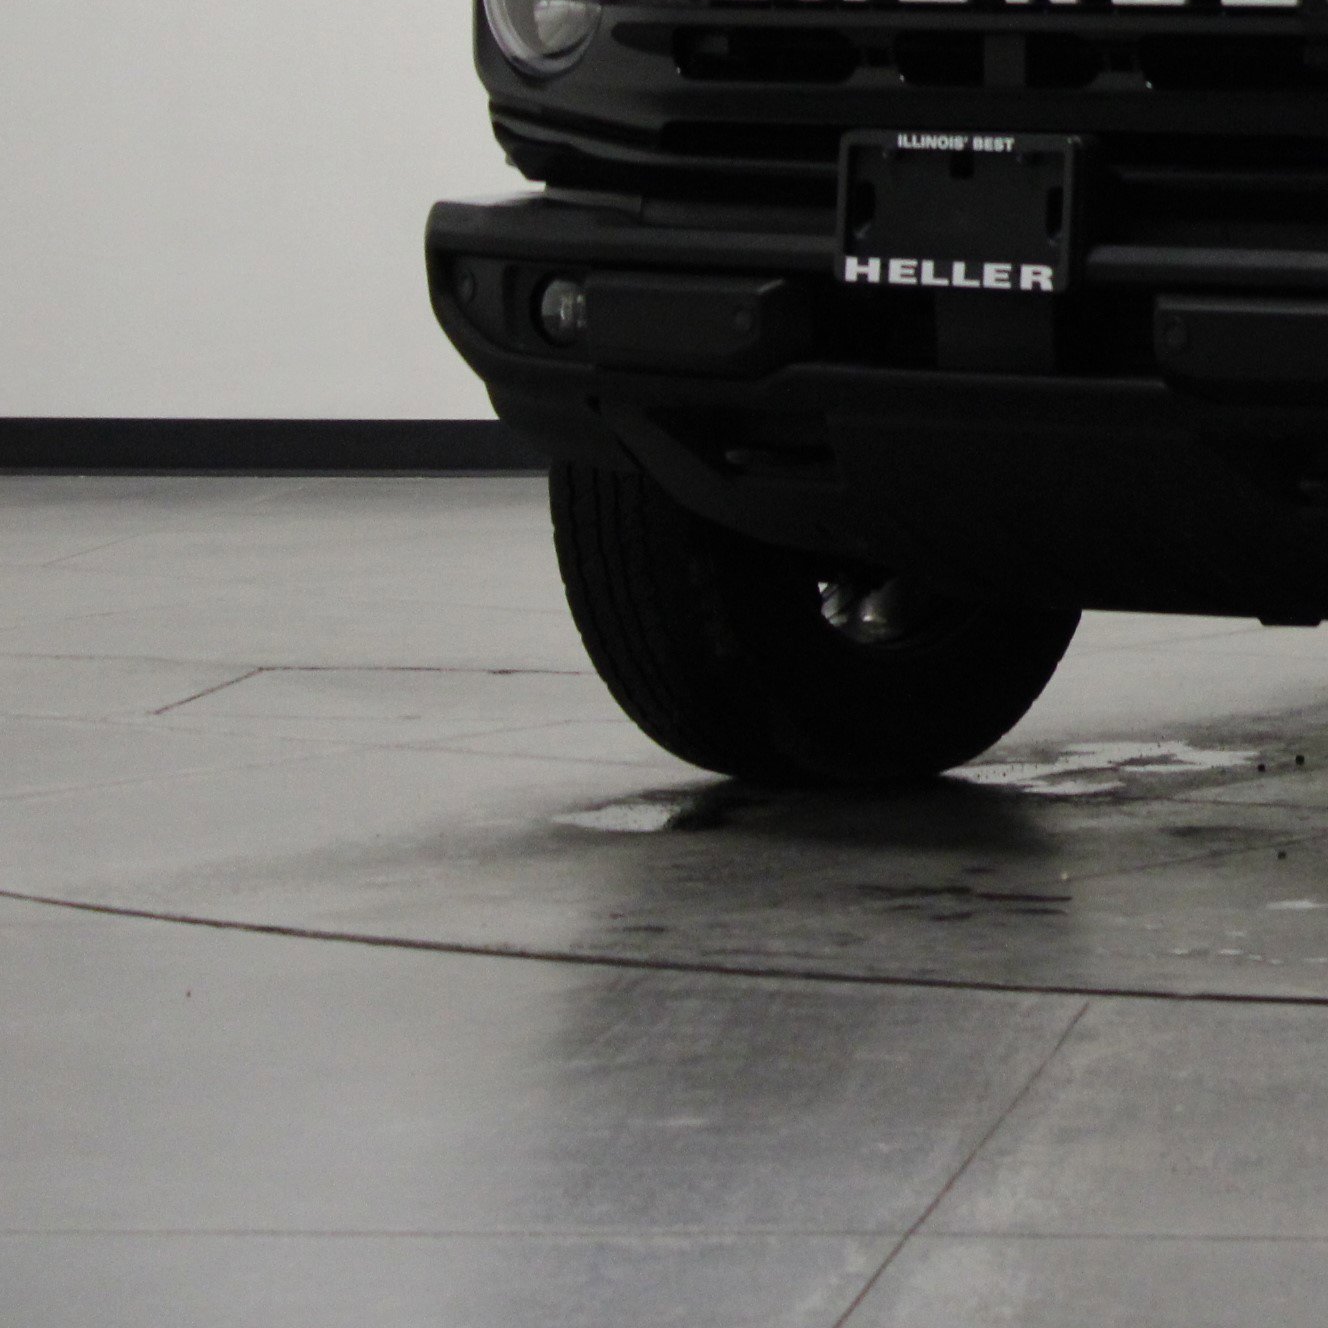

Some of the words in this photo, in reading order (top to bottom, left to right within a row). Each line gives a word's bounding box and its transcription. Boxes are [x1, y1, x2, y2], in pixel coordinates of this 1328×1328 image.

[896, 133, 969, 151] ILLINOIS'
[971, 135, 1015, 153] BEST
[844, 256, 1054, 291] HELLER
